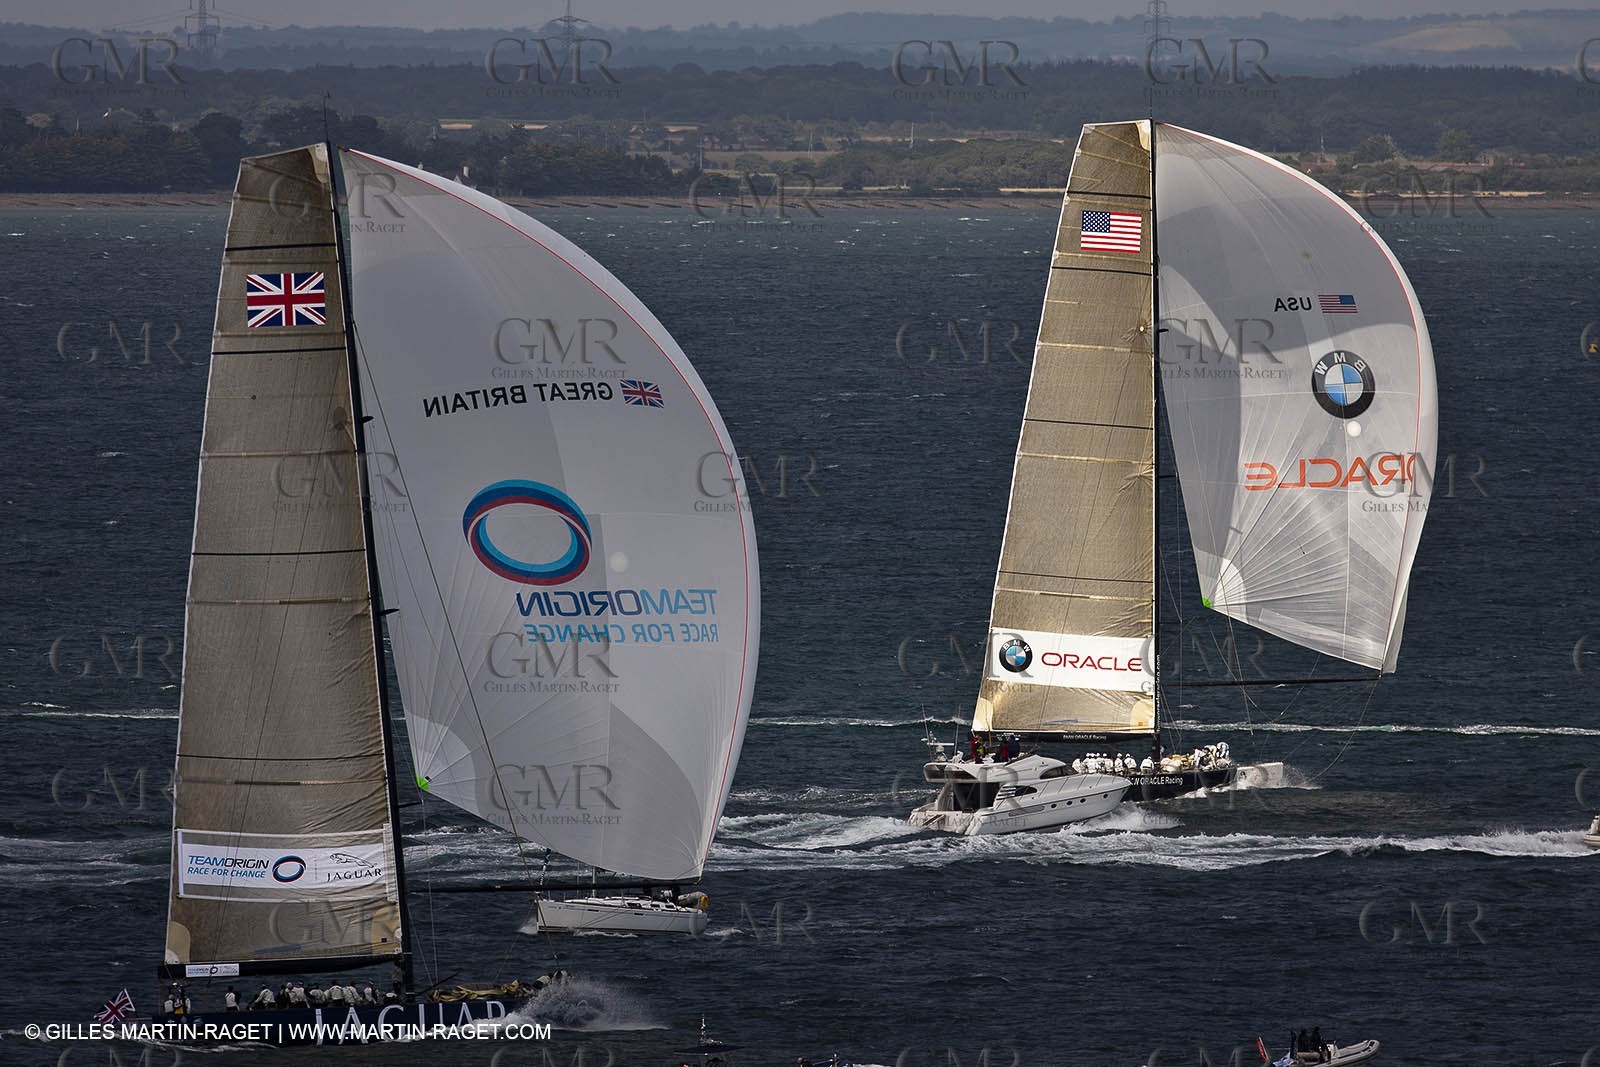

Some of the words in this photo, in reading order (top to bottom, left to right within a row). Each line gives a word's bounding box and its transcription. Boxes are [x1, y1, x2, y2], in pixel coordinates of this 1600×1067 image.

[1003, 640, 1030, 653] BMW
[1041, 652, 1142, 672] ORACLE
[1140, 776, 1164, 785] ORACLE
[1165, 776, 1183, 785] Racing
[188, 855, 269, 869] TEAMORIGIN
[187, 867, 209, 875] RACE
[211, 868, 229, 876] FOR
[231, 869, 266, 878] CHANGE
[327, 868, 382, 882] JAGUAR
